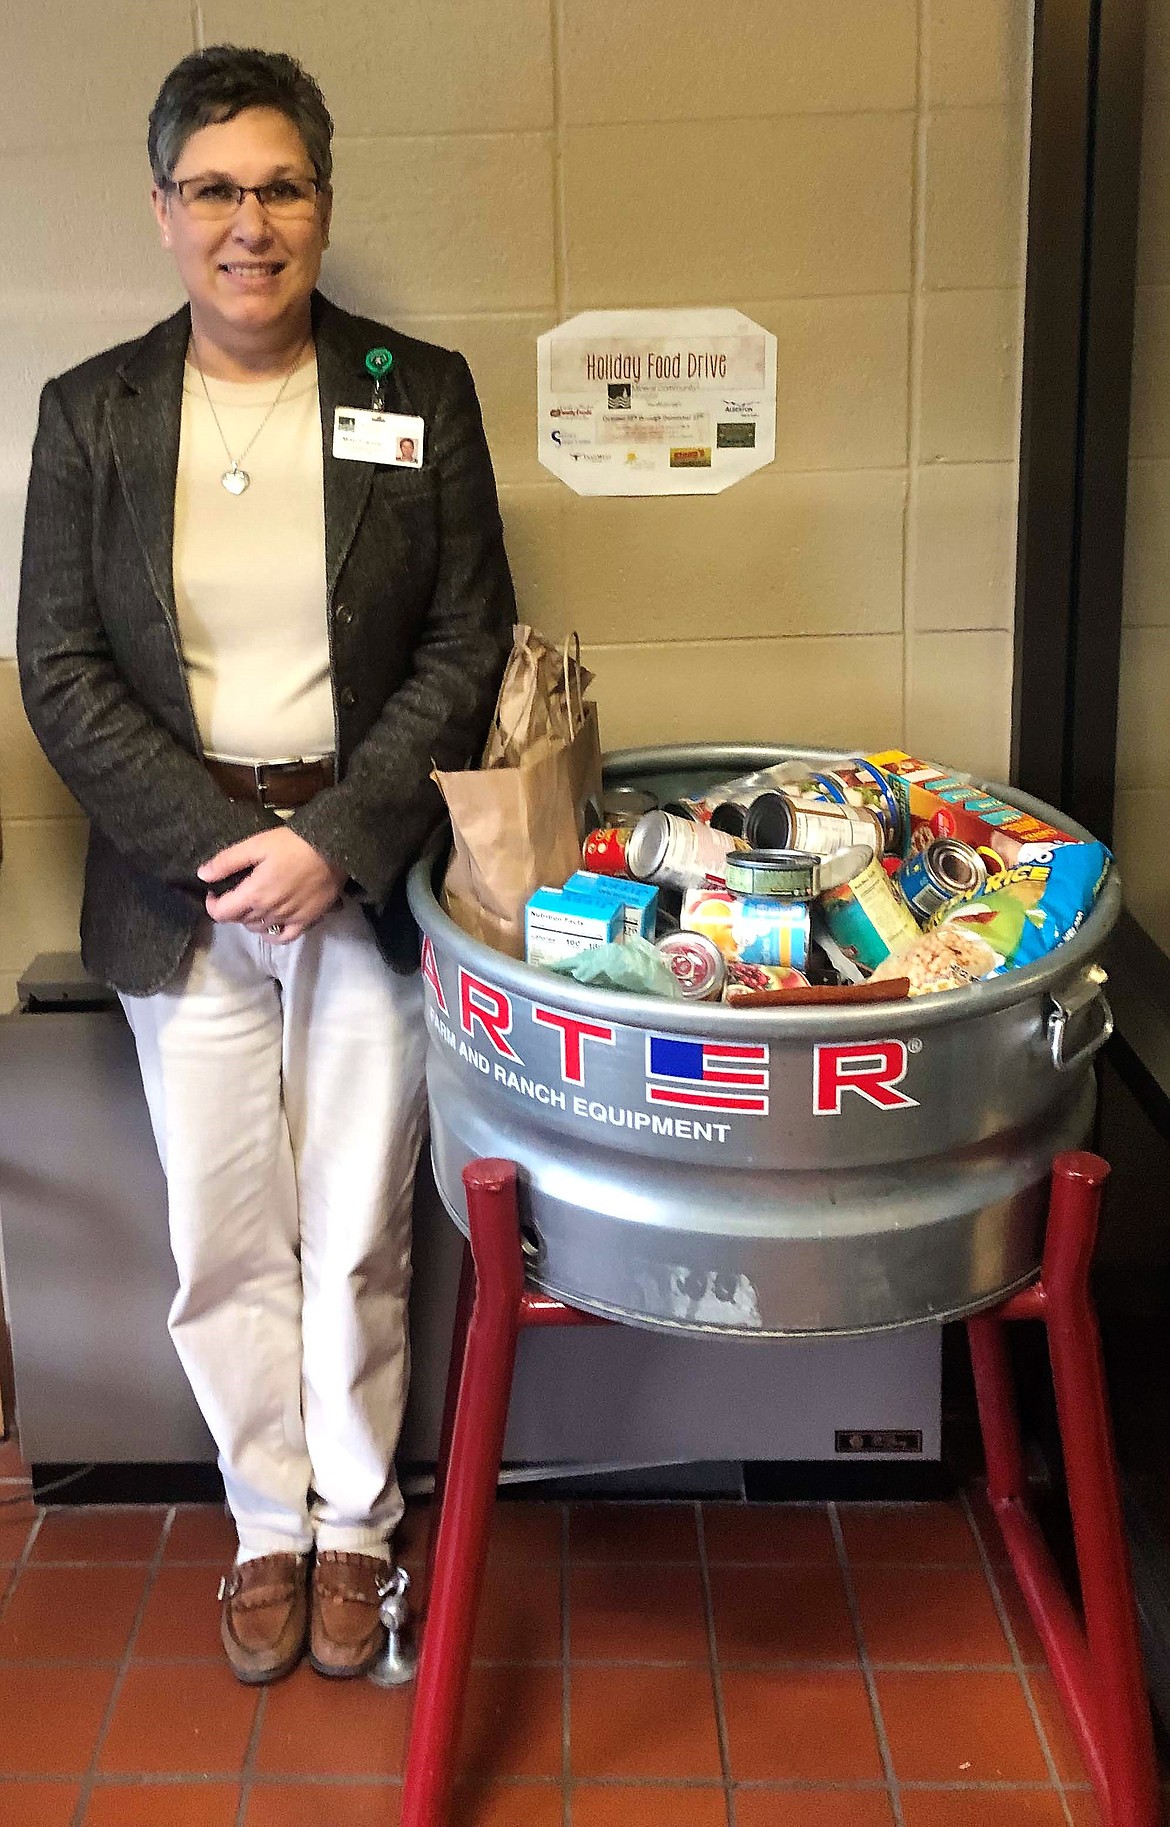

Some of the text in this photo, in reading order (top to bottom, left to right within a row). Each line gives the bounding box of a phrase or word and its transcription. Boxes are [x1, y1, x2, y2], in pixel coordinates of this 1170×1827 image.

[587, 353, 727, 383] Holiday Food Drive
[985, 864, 1051, 894] RICE
[430, 1006, 731, 1144] FARM AND RANCH EQUIPMENT
